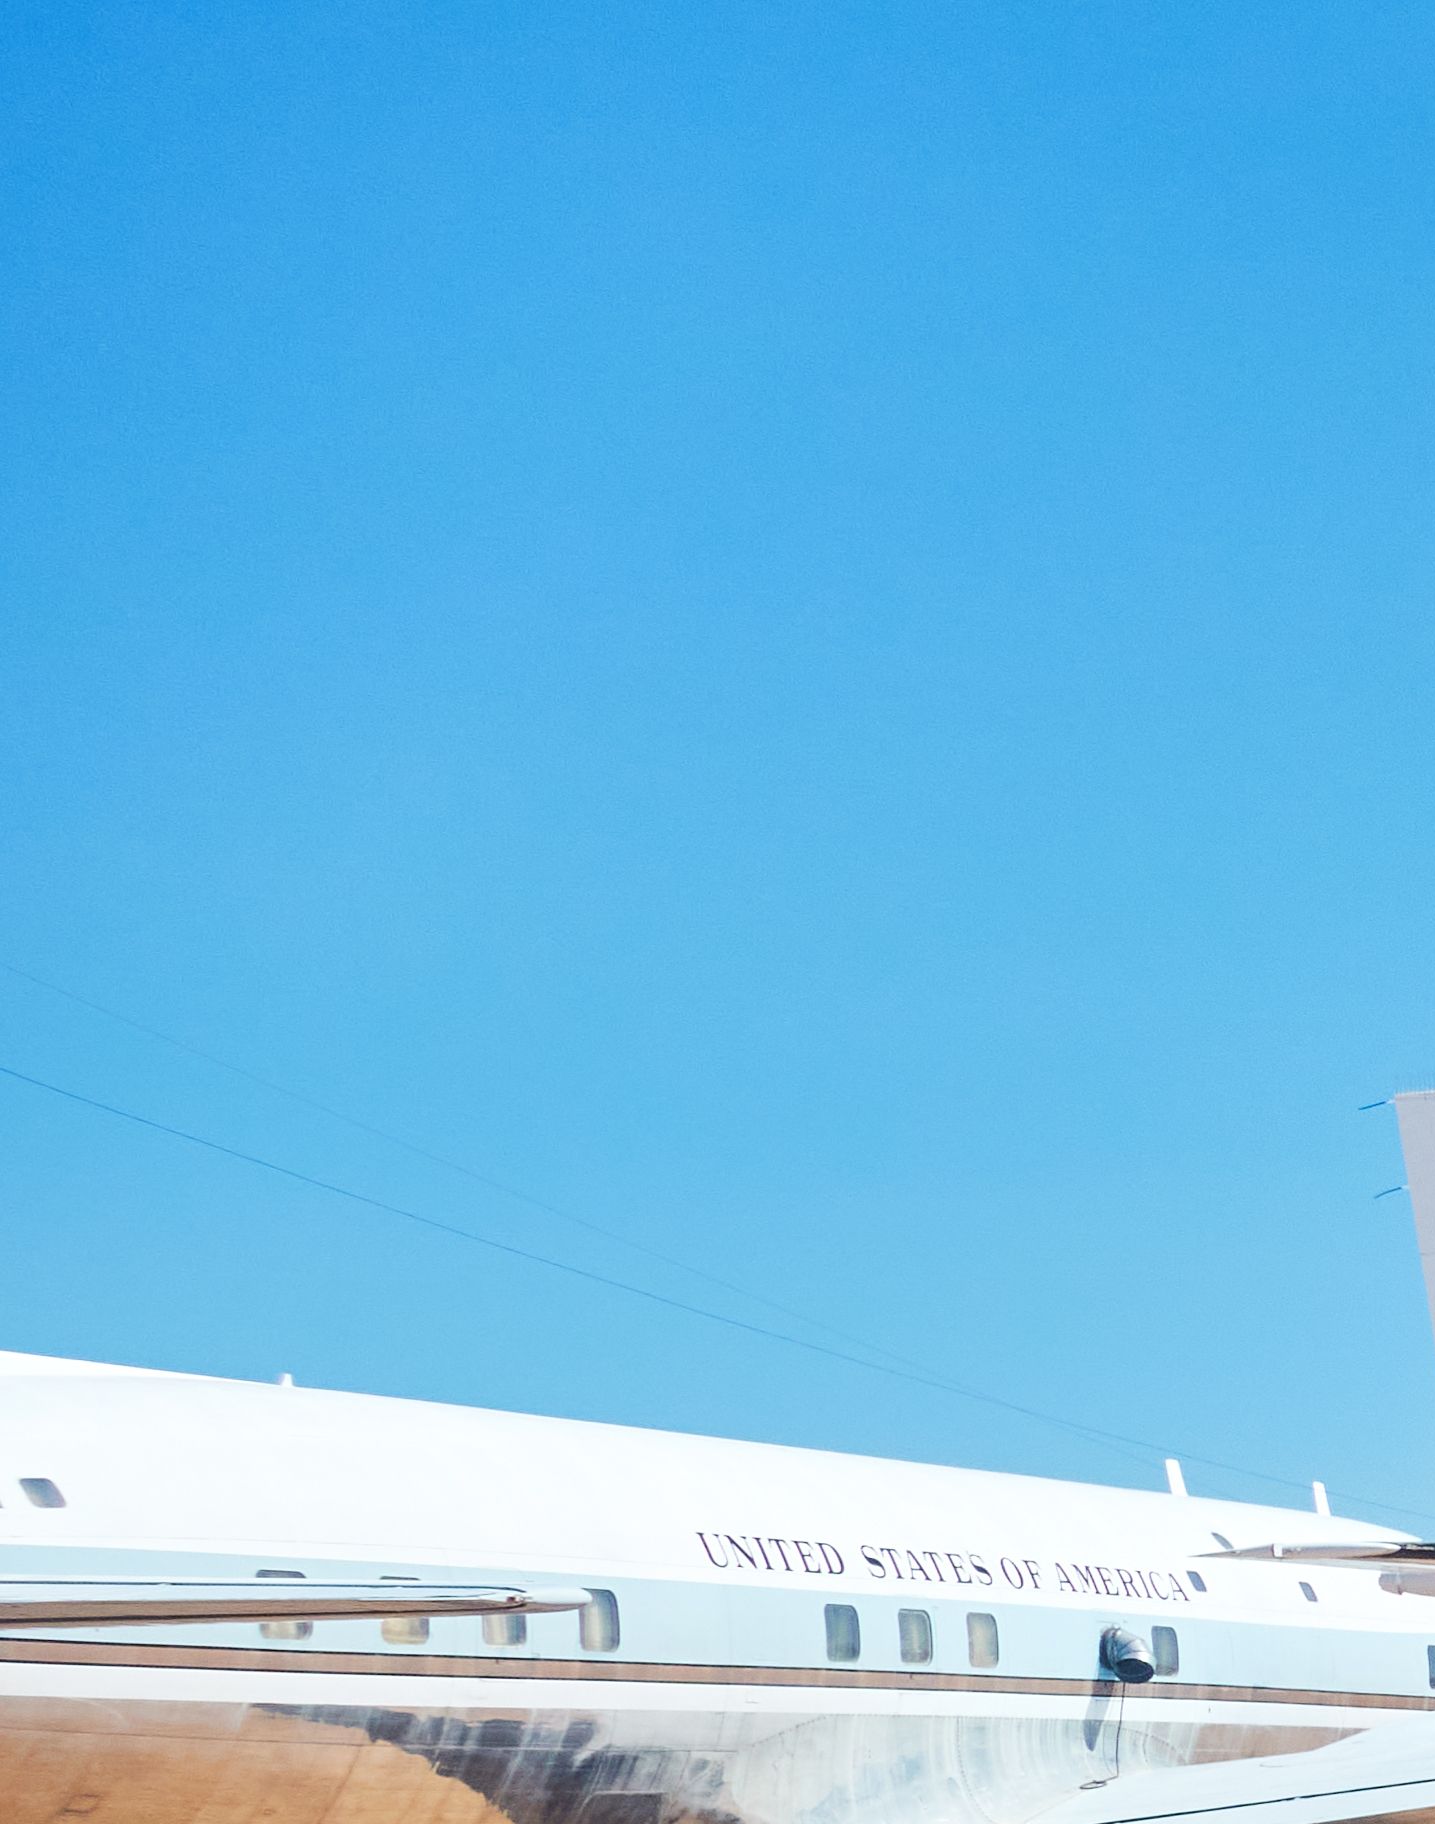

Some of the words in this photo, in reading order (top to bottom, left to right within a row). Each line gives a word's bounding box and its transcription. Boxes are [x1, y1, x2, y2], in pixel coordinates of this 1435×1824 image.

[696, 1532, 844, 1575] UNITED
[860, 1544, 994, 1586] STATES
[1001, 1557, 1043, 1590] OF
[1055, 1562, 1190, 1602] AMERICA
